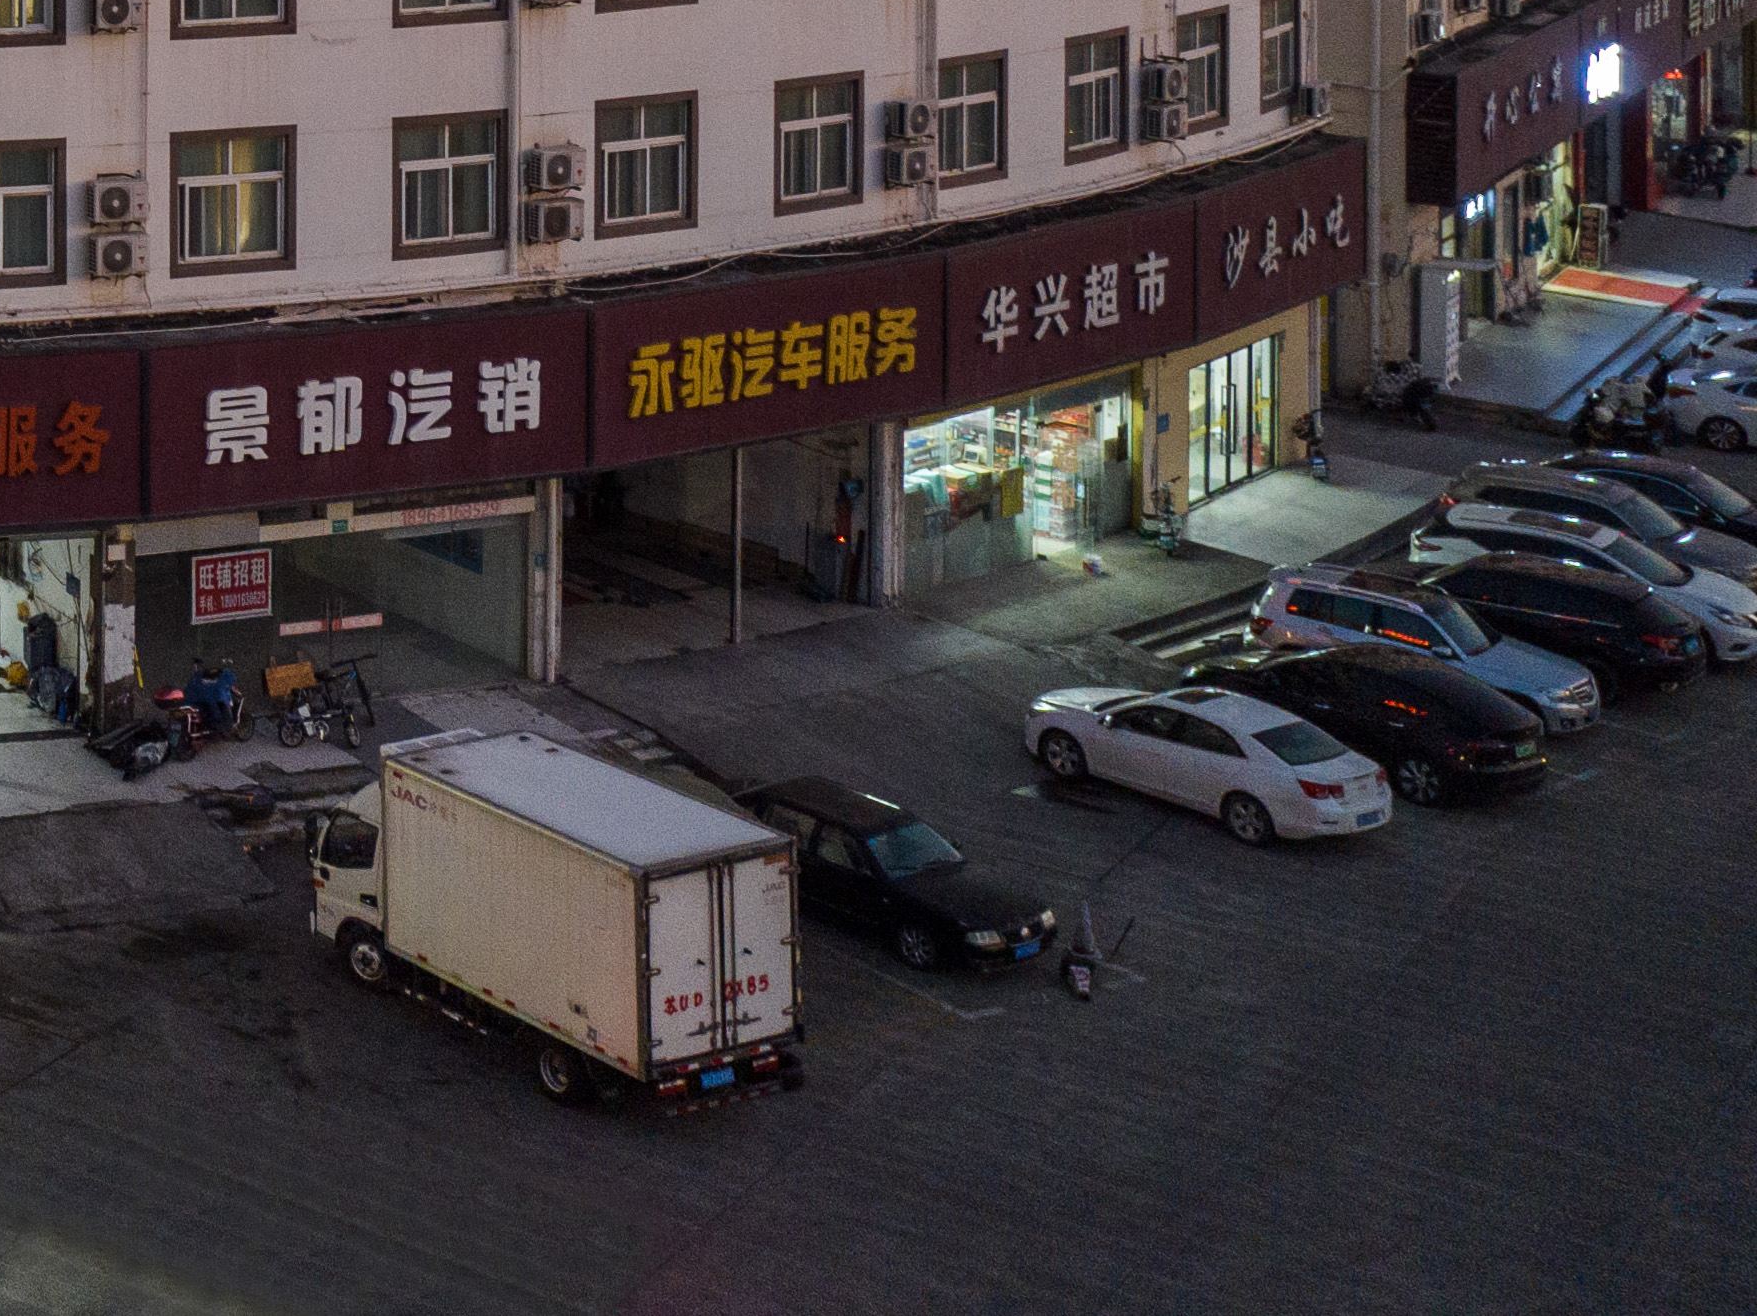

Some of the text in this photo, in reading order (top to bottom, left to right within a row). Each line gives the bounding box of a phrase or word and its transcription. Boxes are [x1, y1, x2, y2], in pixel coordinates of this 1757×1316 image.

[1225, 193, 1351, 290] 沙县小吃
[981, 250, 1170, 354] 华兴超市
[203, 356, 543, 466] 景郁汽销
[627, 306, 919, 420] 永驱汽车服务
[199, 557, 266, 590] 旺铺招租
[390, 785, 428, 811] JAC
